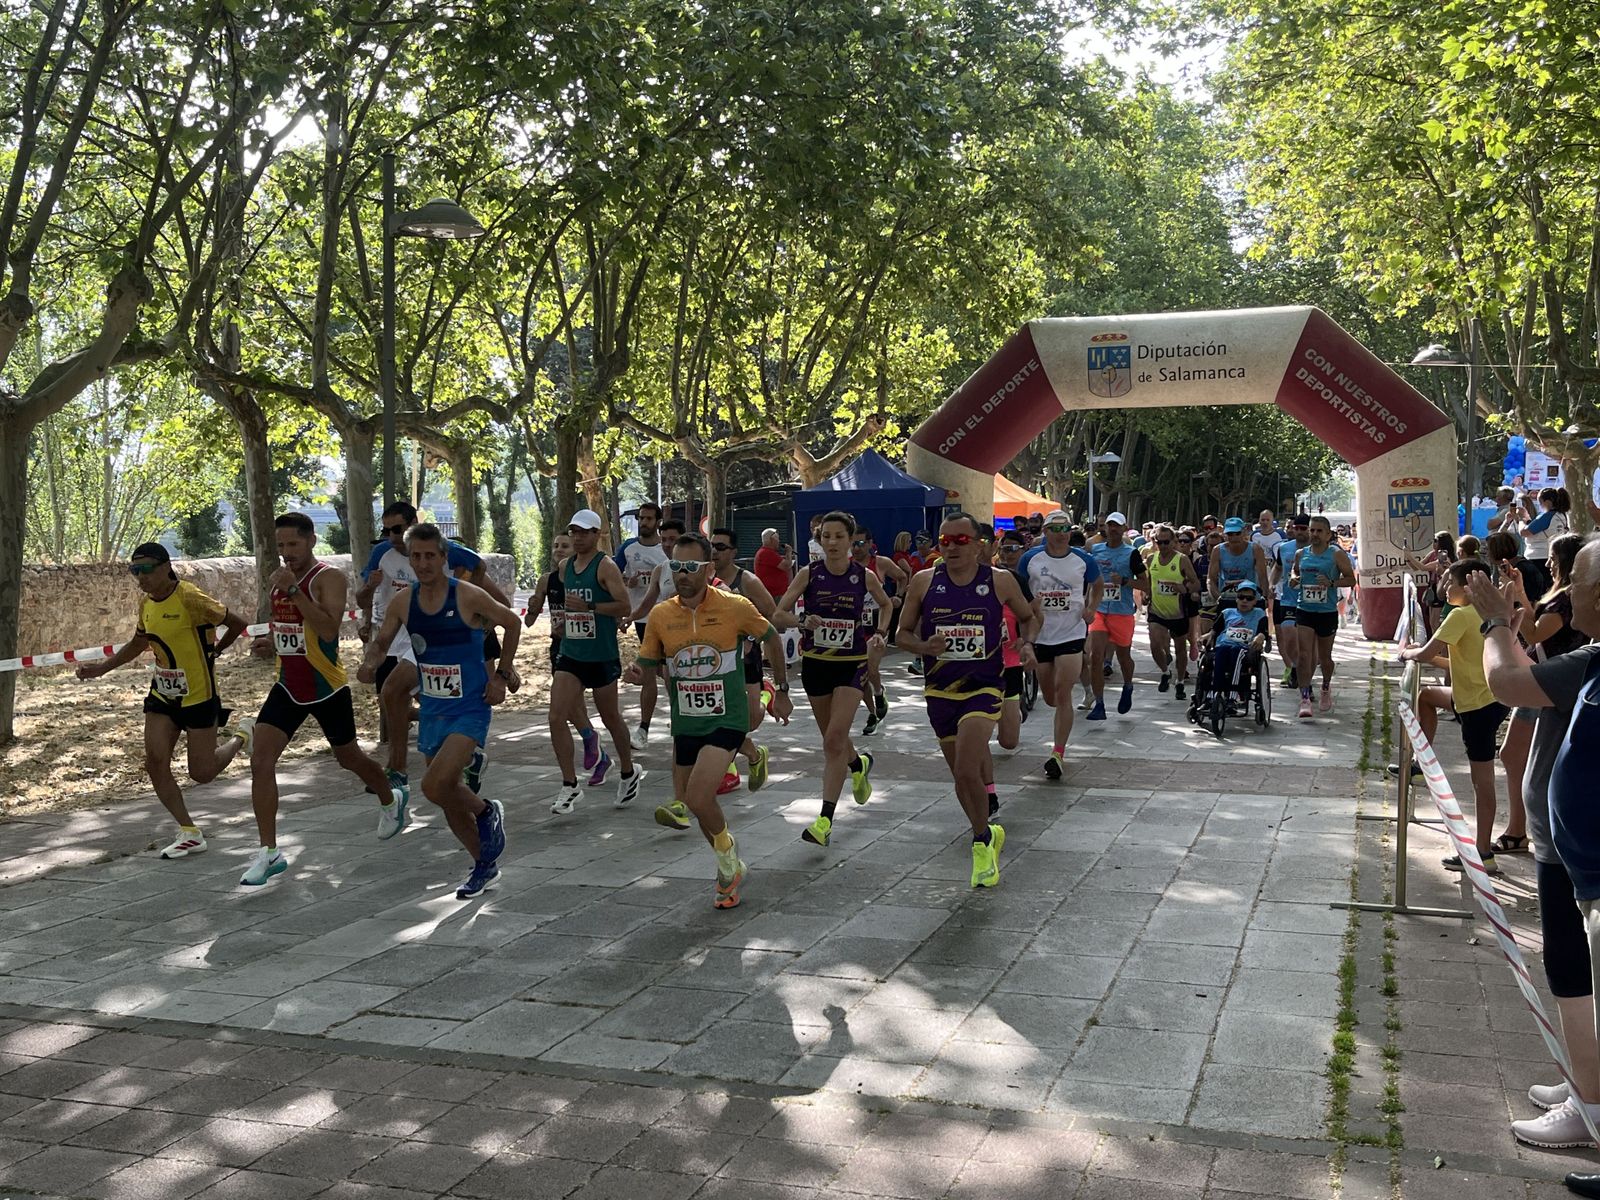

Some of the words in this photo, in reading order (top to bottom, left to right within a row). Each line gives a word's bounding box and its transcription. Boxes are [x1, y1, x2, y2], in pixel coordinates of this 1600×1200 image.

[1137, 341, 1227, 362] Diputación
[1138, 372, 1152, 383] de
[1159, 367, 1246, 382] Salamanca
[1304, 348, 1336, 376] CON
[1334, 372, 1408, 434] NUESTROS
[938, 427, 967, 455] CON
[964, 414, 984, 430] EL
[981, 359, 1040, 414] DEPORTE
[1295, 367, 1387, 443] DEPORTISTAS
[1371, 575, 1381, 585] de
[1306, 590, 1322, 599] 211
[1044, 598, 1066, 607] 235
[570, 621, 590, 633] 115
[820, 621, 854, 629] edunia
[277, 634, 298, 648] 190
[821, 628, 848, 641] 167
[1230, 632, 1248, 641] 203
[944, 638, 977, 653] 256
[159, 677, 182, 690] 134
[427, 675, 454, 691] 114
[678, 683, 722, 692] bedunia
[685, 692, 716, 708] 155
